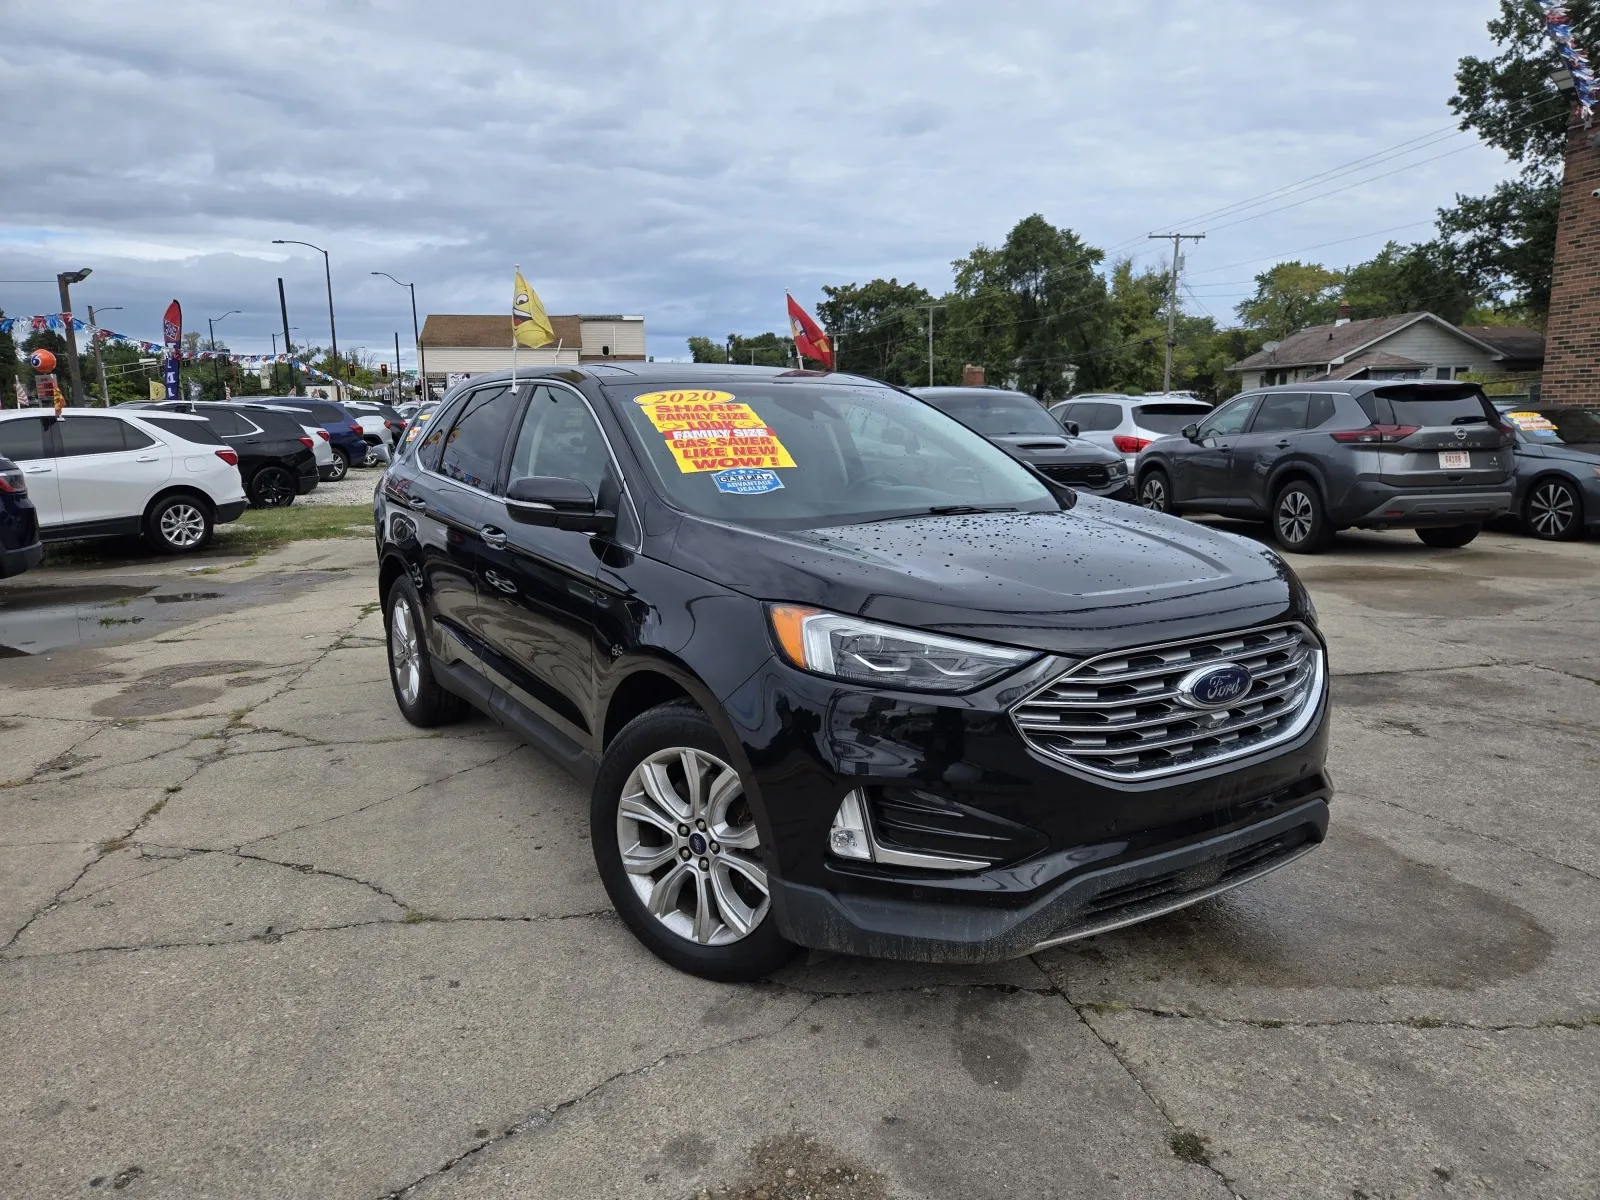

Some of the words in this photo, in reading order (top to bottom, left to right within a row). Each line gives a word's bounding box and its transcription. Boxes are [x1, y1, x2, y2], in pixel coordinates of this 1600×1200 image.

[654, 391, 717, 404] 2020
[655, 404, 743, 413] SHARP
[656, 412, 712, 421] FAMILY
[717, 412, 751, 420] SIZE
[686, 420, 736, 430] LOOK
[672, 430, 731, 439] FAMILY
[733, 429, 768, 437] SIZE
[672, 436, 774, 449] GAS-SAVER
[682, 448, 728, 459] LIKE
[733, 446, 778, 456] NEW
[692, 457, 764, 470] WOW
[726, 480, 773, 488] ADVANTAGE
[1207, 674, 1240, 699] Ford
